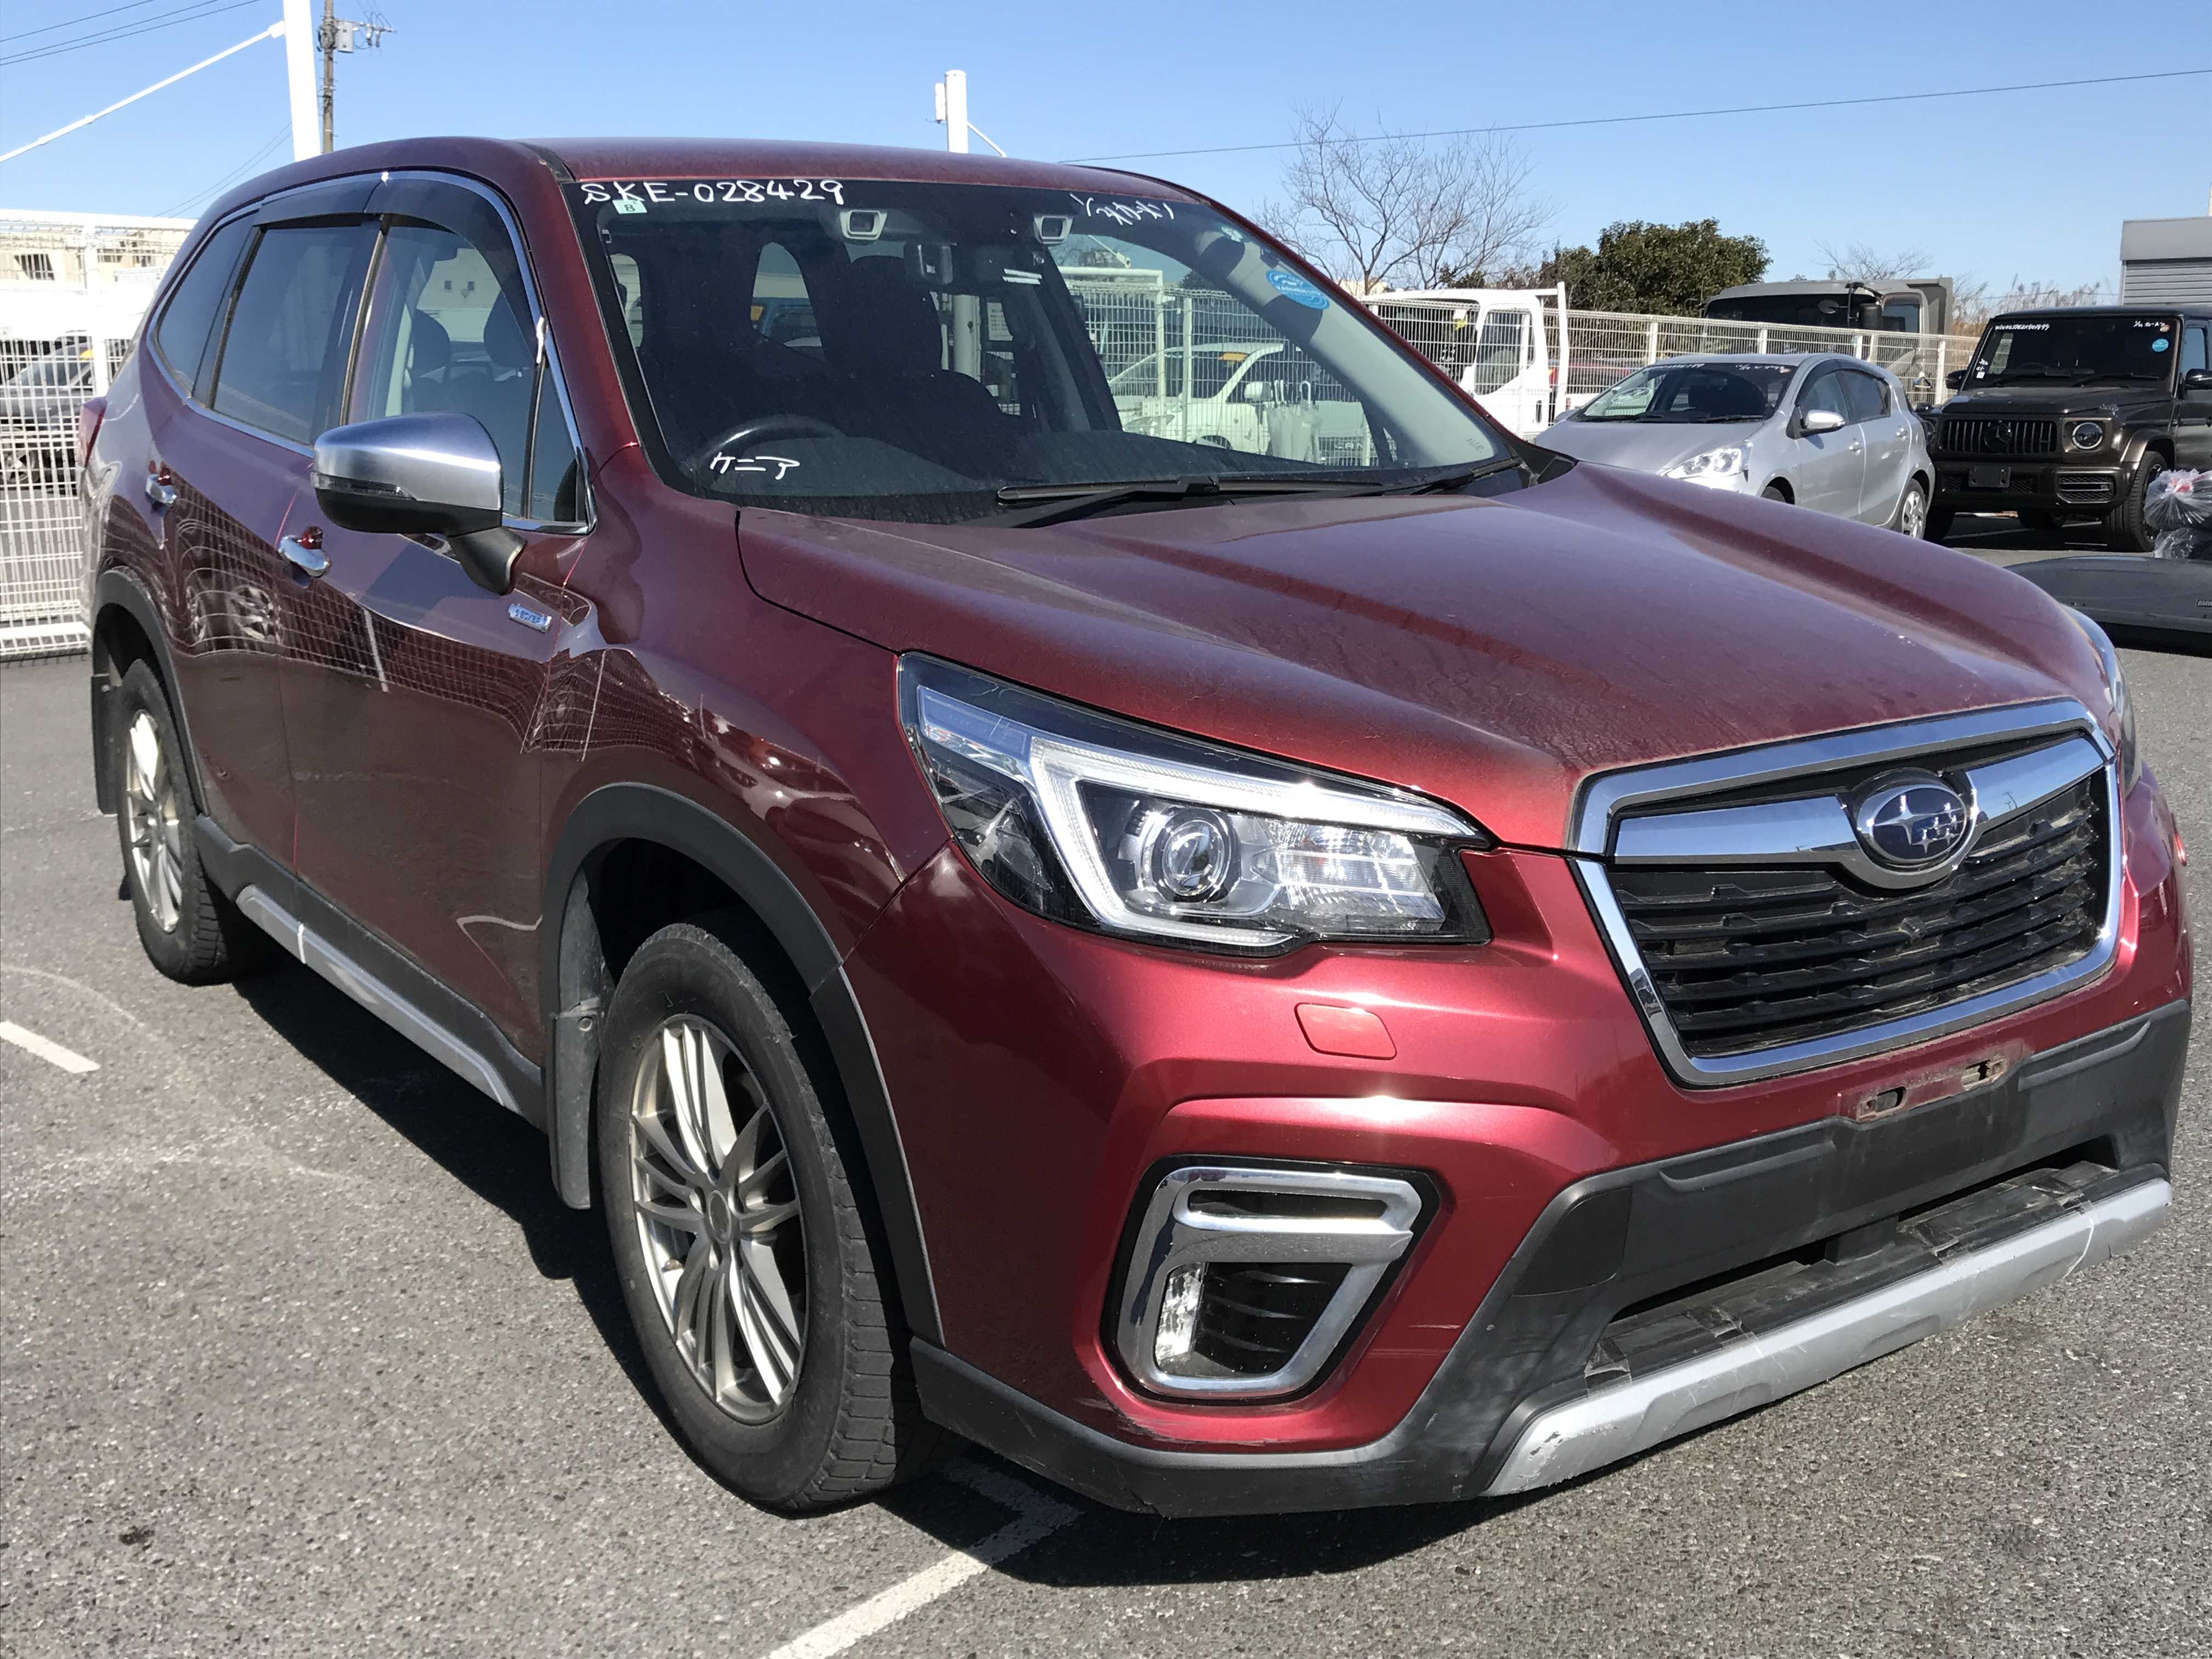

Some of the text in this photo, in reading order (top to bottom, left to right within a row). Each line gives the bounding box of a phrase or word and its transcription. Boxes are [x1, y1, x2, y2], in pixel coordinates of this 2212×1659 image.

[580, 180, 844, 207] SKE-028429
[709, 452, 800, 480] ケニア
